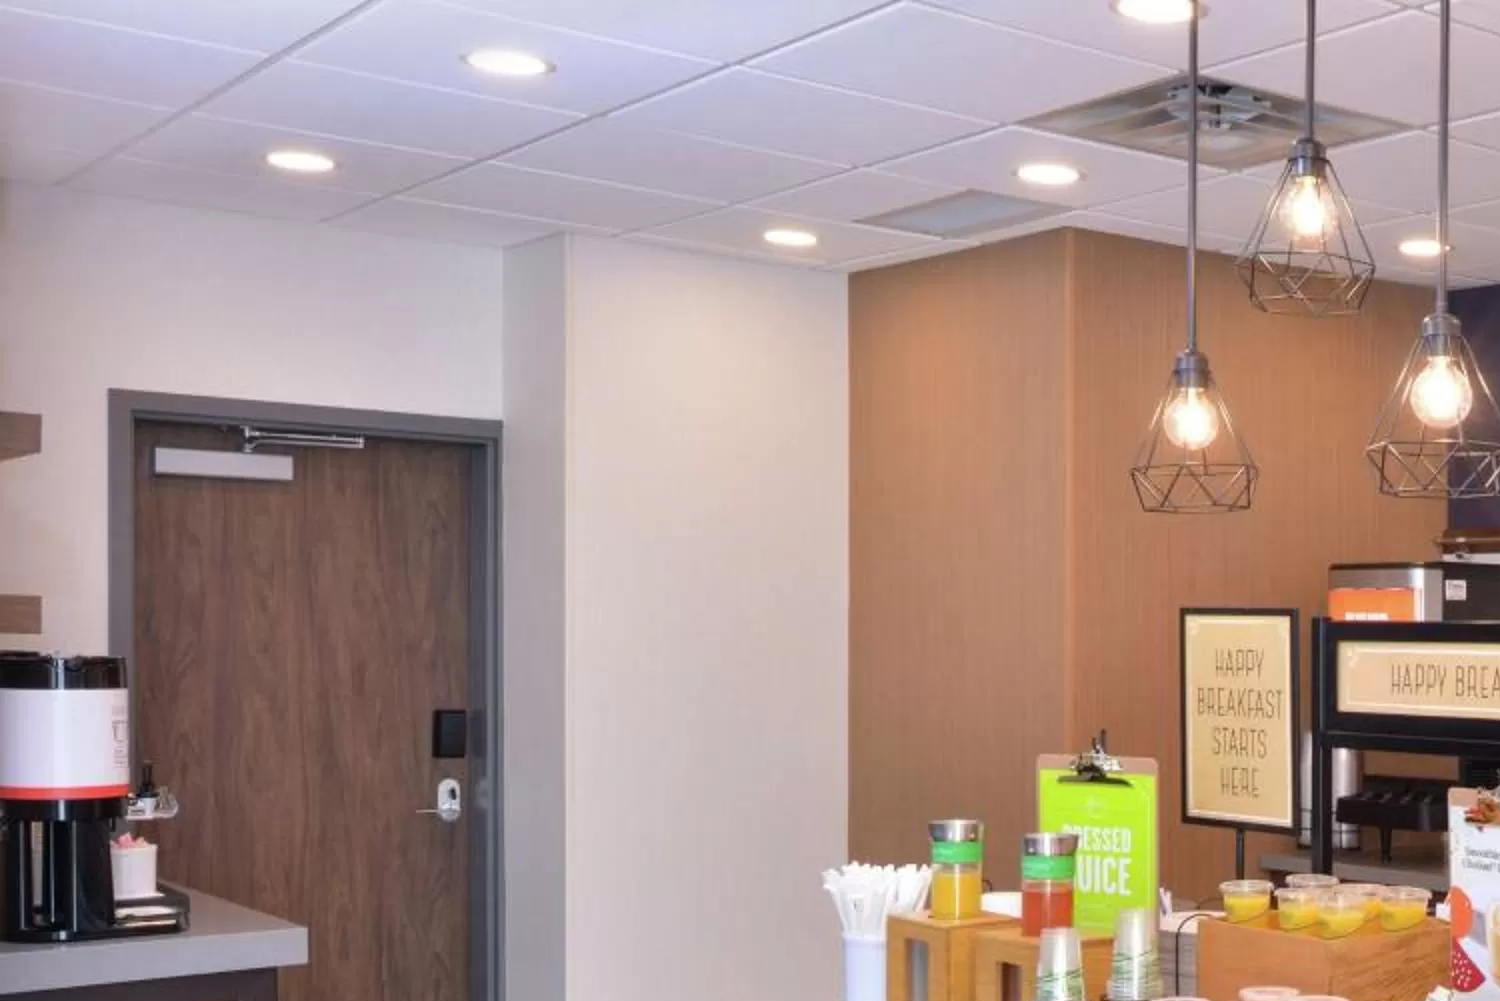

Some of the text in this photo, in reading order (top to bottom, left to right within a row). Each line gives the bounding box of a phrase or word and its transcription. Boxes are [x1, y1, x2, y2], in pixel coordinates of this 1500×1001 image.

[1215, 647, 1265, 680] HAPPY
[1390, 663, 1447, 697] HAPPY
[1197, 687, 1282, 720] BREAKFAST
[1212, 727, 1268, 760] STARTS
[1220, 767, 1261, 800] HERE
[1076, 853, 1132, 896] UICE
